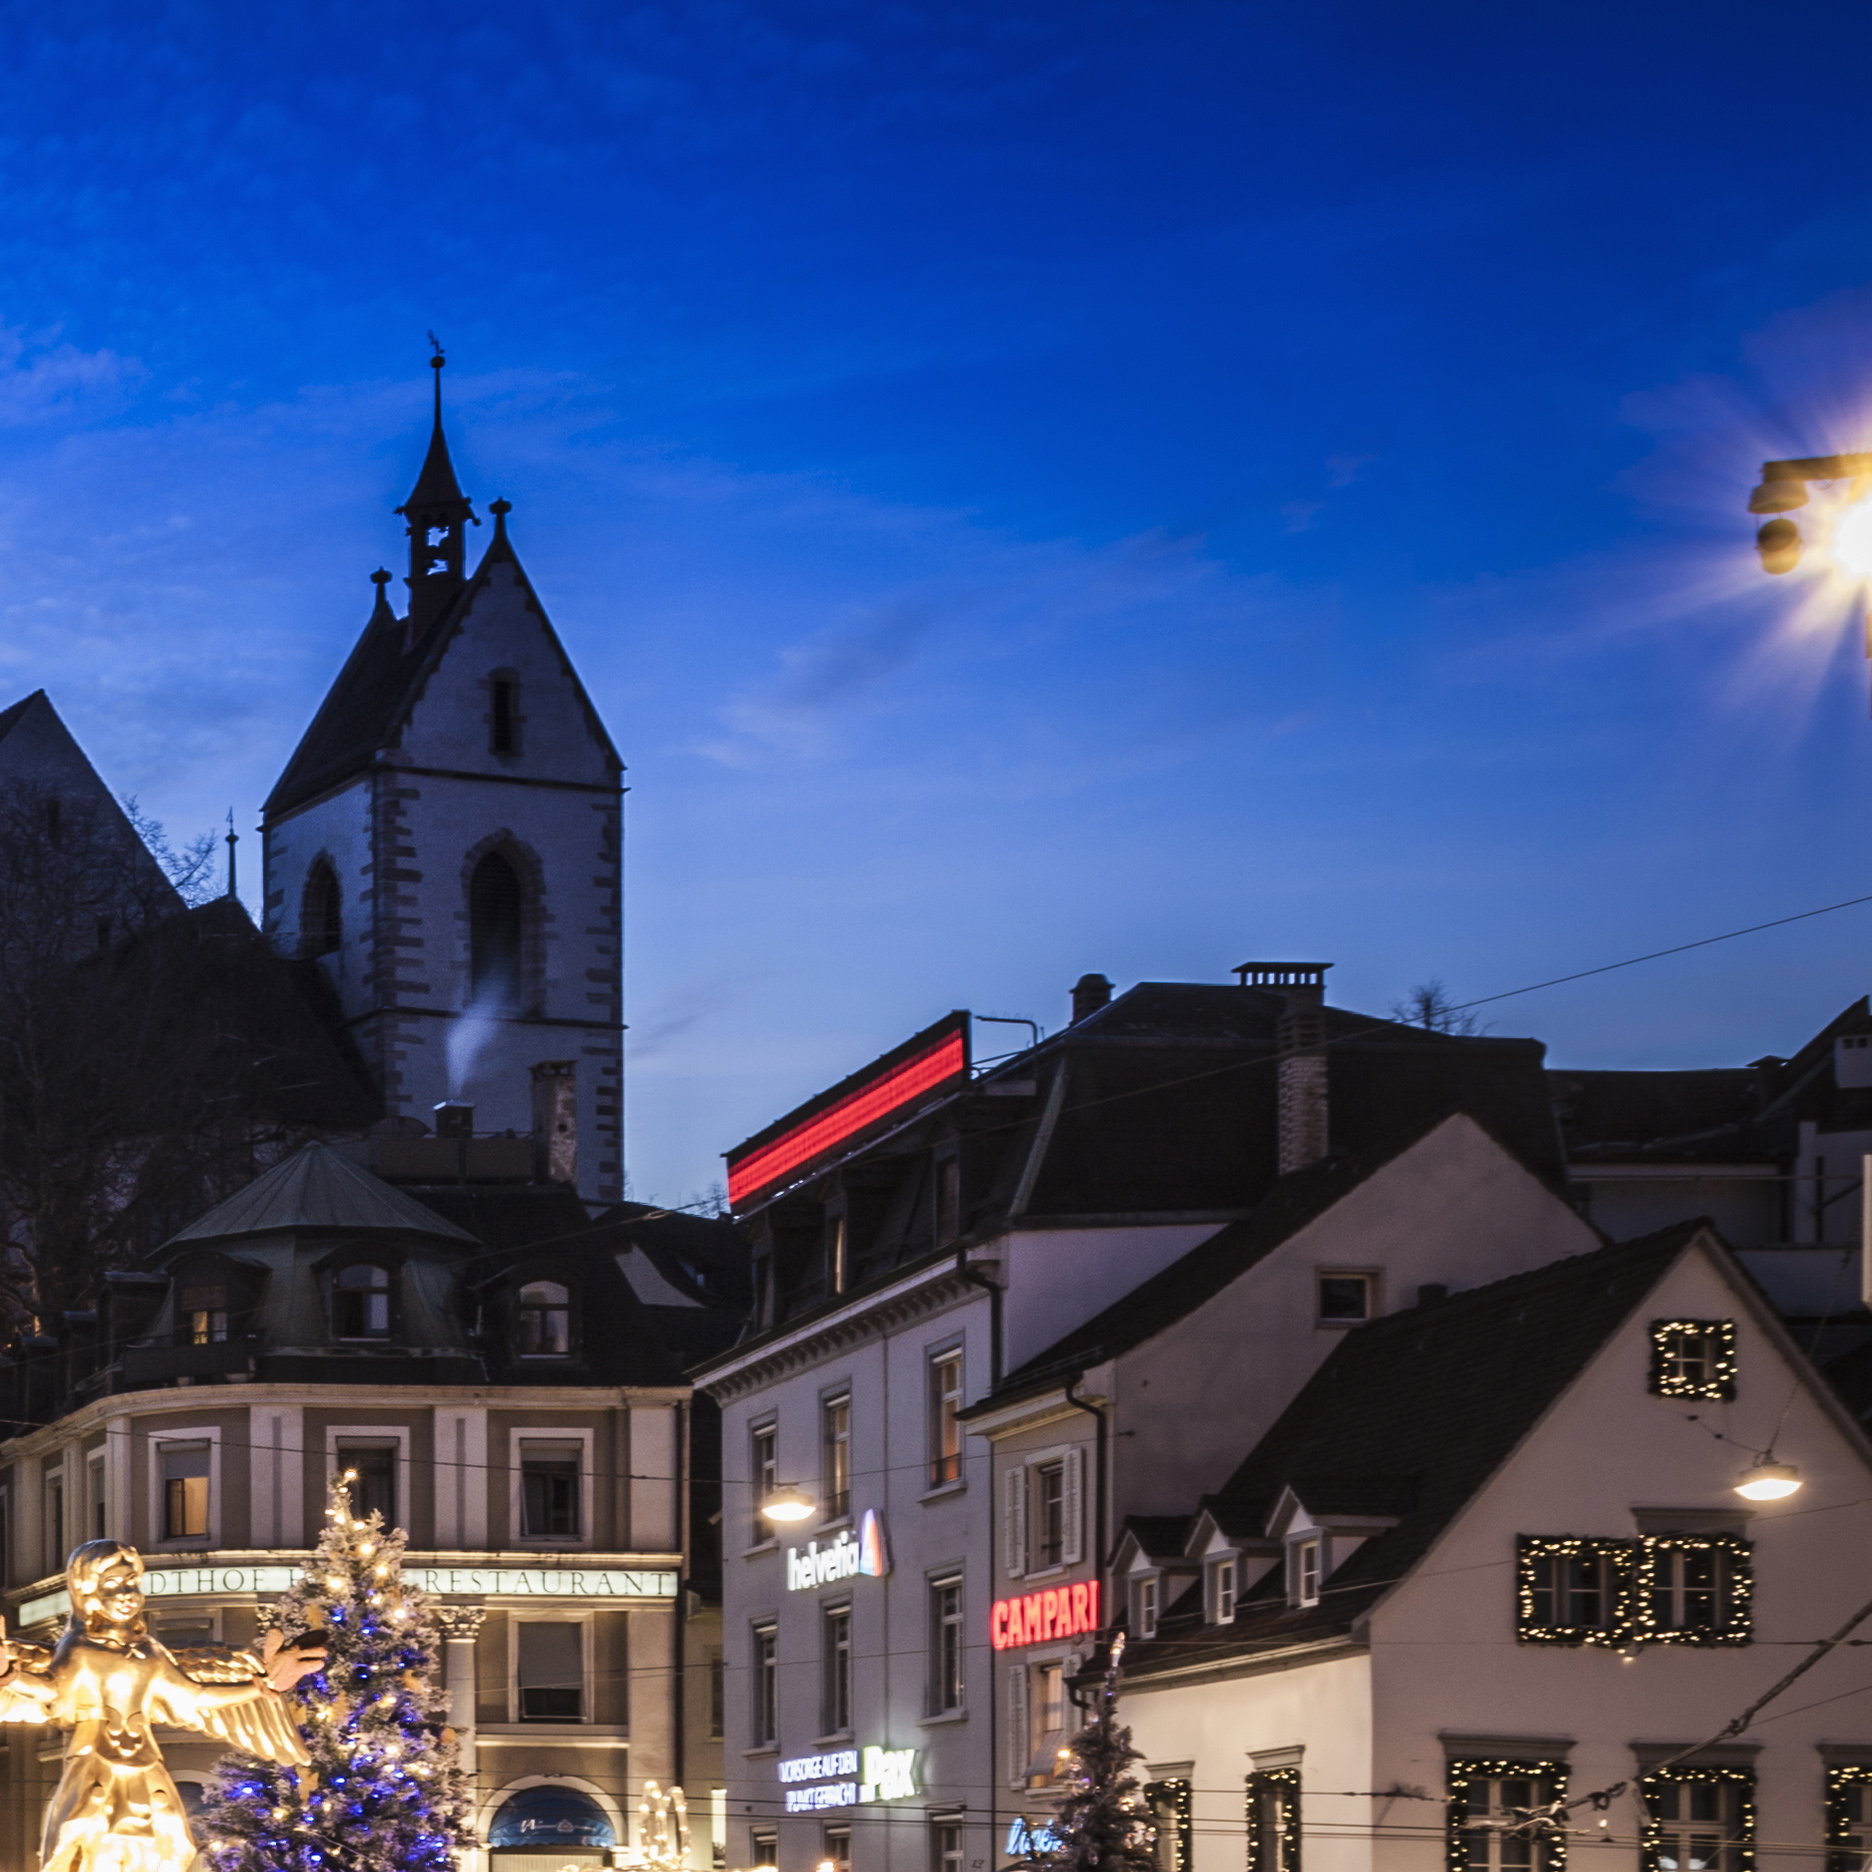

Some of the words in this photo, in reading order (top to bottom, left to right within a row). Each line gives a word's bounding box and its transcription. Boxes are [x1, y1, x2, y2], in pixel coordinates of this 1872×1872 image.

[424, 1570, 671, 1596] RESTAURANT
[787, 1531, 860, 1591] helvetia
[991, 1580, 1100, 1650] CAMPARI
